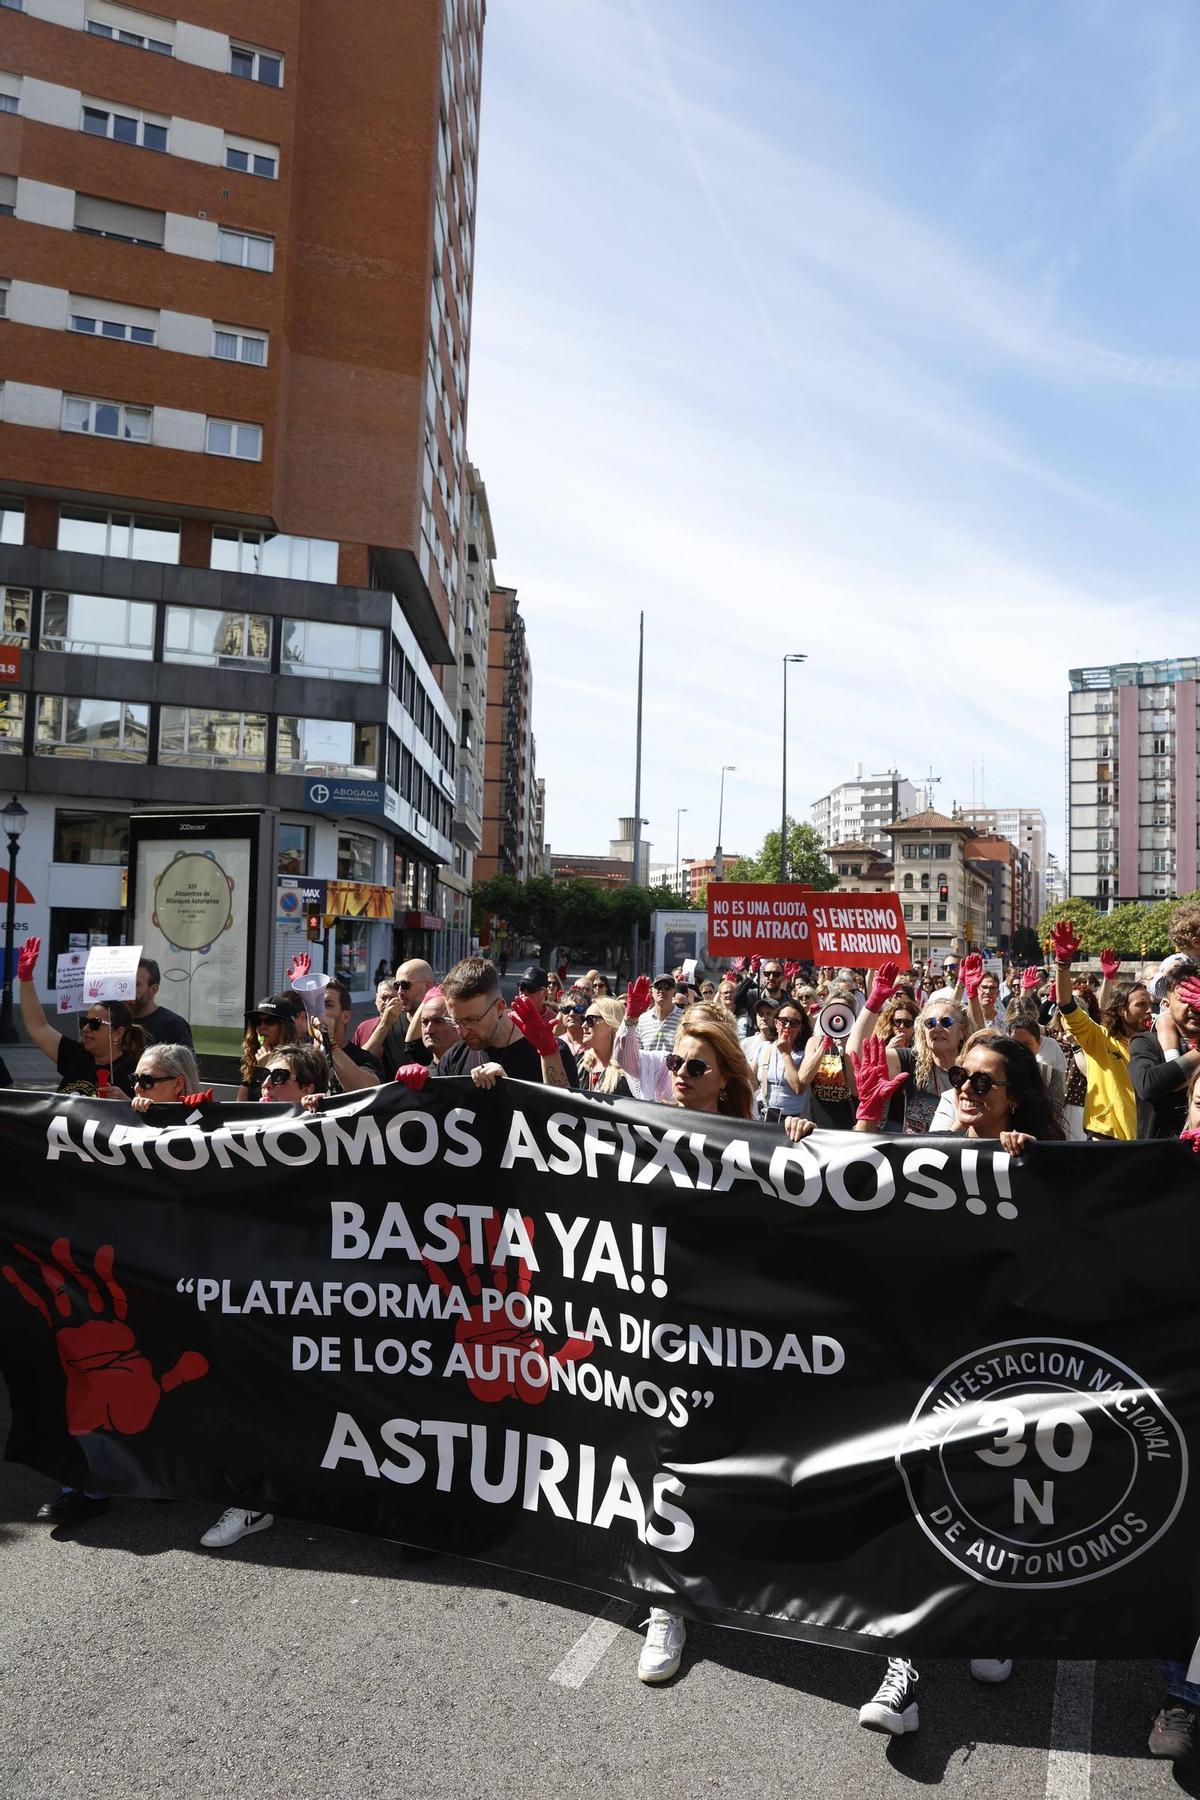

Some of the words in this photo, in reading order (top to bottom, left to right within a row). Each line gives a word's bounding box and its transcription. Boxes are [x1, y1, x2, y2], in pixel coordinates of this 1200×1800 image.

[332, 788, 379, 798] ABOGADA
[303, 889, 320, 898] MAX
[713, 901, 729, 915] NO
[732, 901, 745, 915] ES
[747, 901, 770, 916] UNA
[773, 902, 807, 917] CUOTA
[812, 908, 827, 928] SI
[831, 908, 897, 930] ENFERMO
[713, 919, 729, 938] ES
[732, 920, 751, 938] UN
[755, 921, 808, 940] ATRACO
[818, 932, 837, 952] ME
[840, 933, 901, 954] ARRUINO
[46, 1108, 483, 1169] AUTÓNOMOS
[500, 1110, 1019, 1220] ASFIXIADOS!!
[330, 1201, 540, 1272] BASTA
[545, 1211, 668, 1298] YA!!
[176, 1277, 472, 1322] “PLATAFORMA
[482, 1287, 557, 1335] POR
[564, 1301, 613, 1347] LA
[620, 1313, 846, 1375] DIGNIDAD
[292, 1335, 341, 1371] DE
[354, 1338, 432, 1376] LOS
[443, 1340, 714, 1428] AUTÓNOMOS”
[975, 1407, 1093, 1472] 30
[1088, 1367, 1171, 1461] NACIONAL
[321, 1411, 695, 1553] ASTURIAS
[1013, 1478, 1055, 1525] N
[930, 1504, 966, 1543] DE
[965, 1511, 1149, 1576] AUTONOMOS
